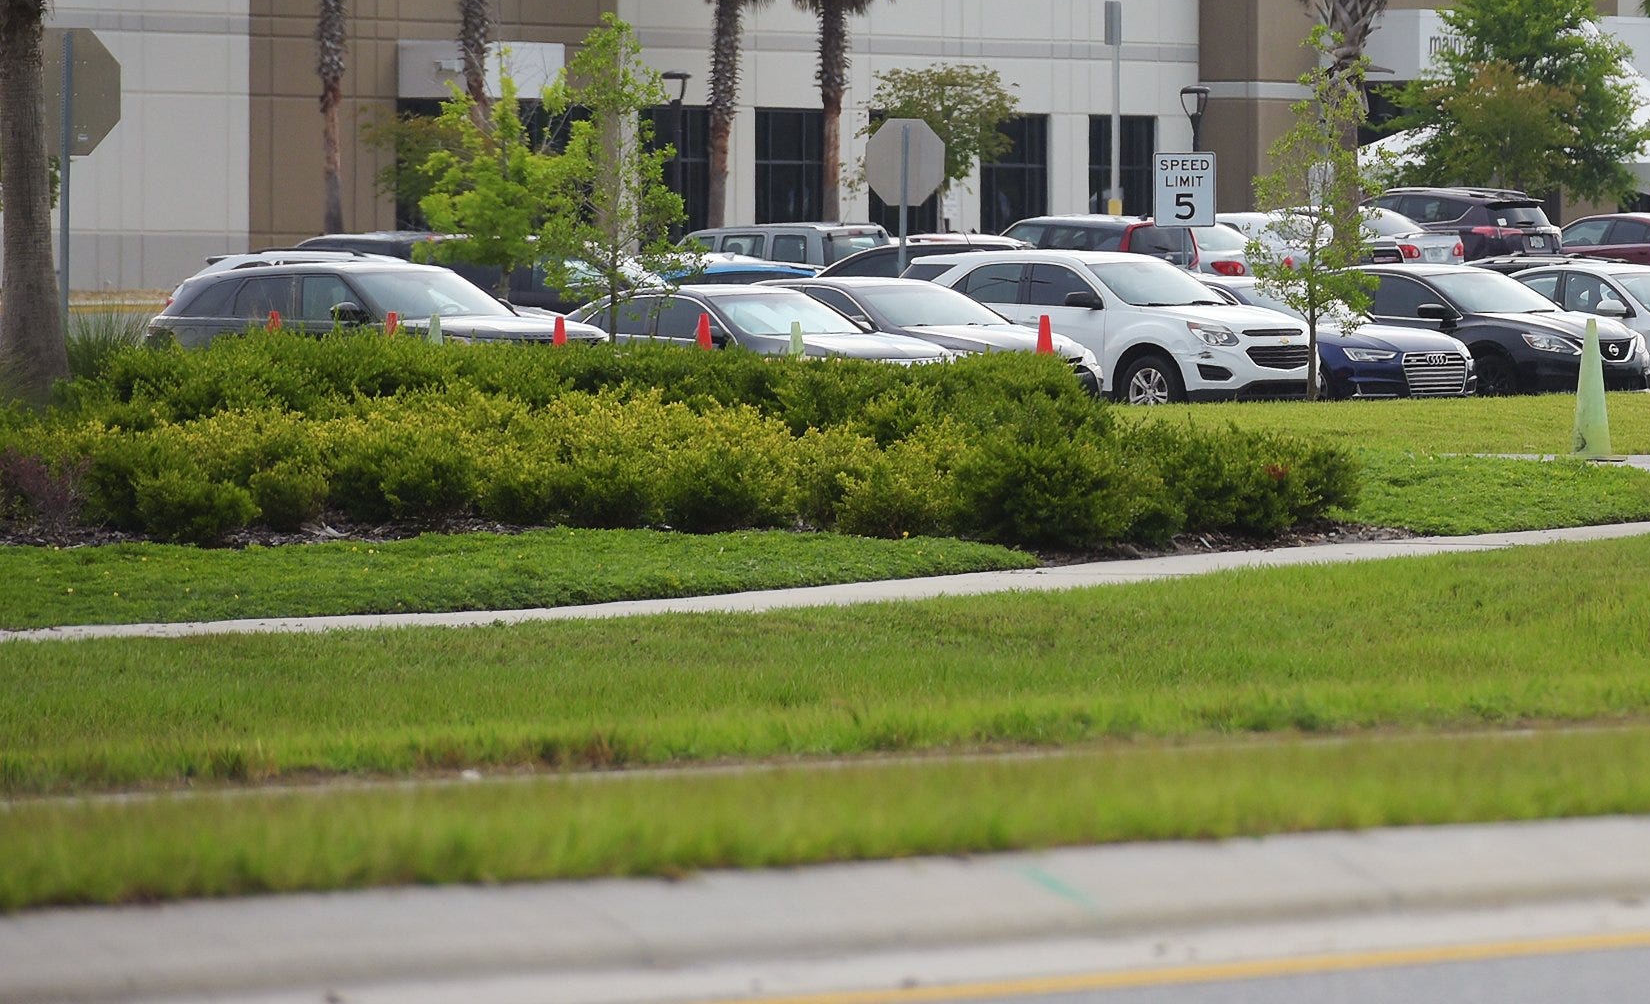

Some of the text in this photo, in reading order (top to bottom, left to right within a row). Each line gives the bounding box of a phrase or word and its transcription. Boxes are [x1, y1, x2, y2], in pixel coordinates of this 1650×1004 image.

[1160, 159, 1210, 171] SPEED
[1165, 175, 1204, 187] LIMIT
[1174, 193, 1195, 220] 5
